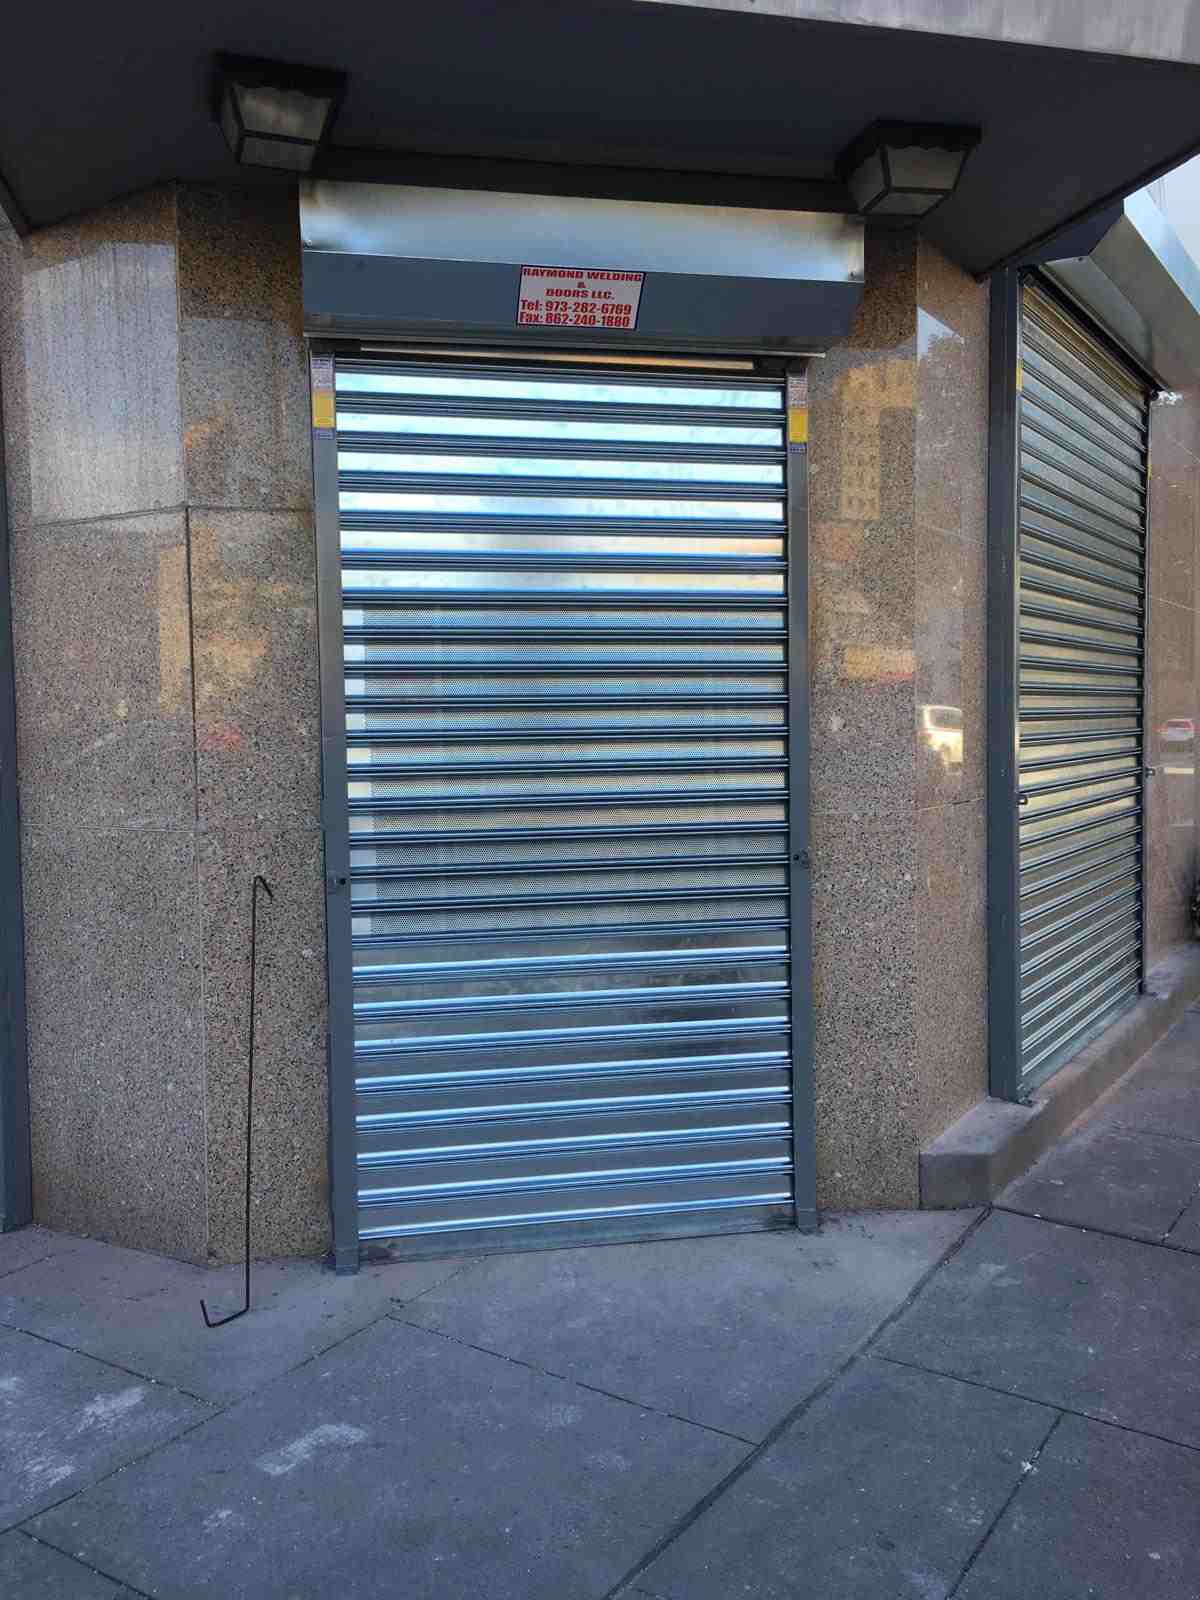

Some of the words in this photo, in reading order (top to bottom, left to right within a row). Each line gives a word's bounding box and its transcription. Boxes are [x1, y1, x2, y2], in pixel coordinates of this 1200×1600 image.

[523, 268, 583, 279] RAYMOND
[587, 271, 642, 282] WELDING
[577, 281, 586, 289] &
[545, 288, 589, 298] DOORS
[521, 299, 542, 312] Tel:
[519, 311, 543, 323] Fax:
